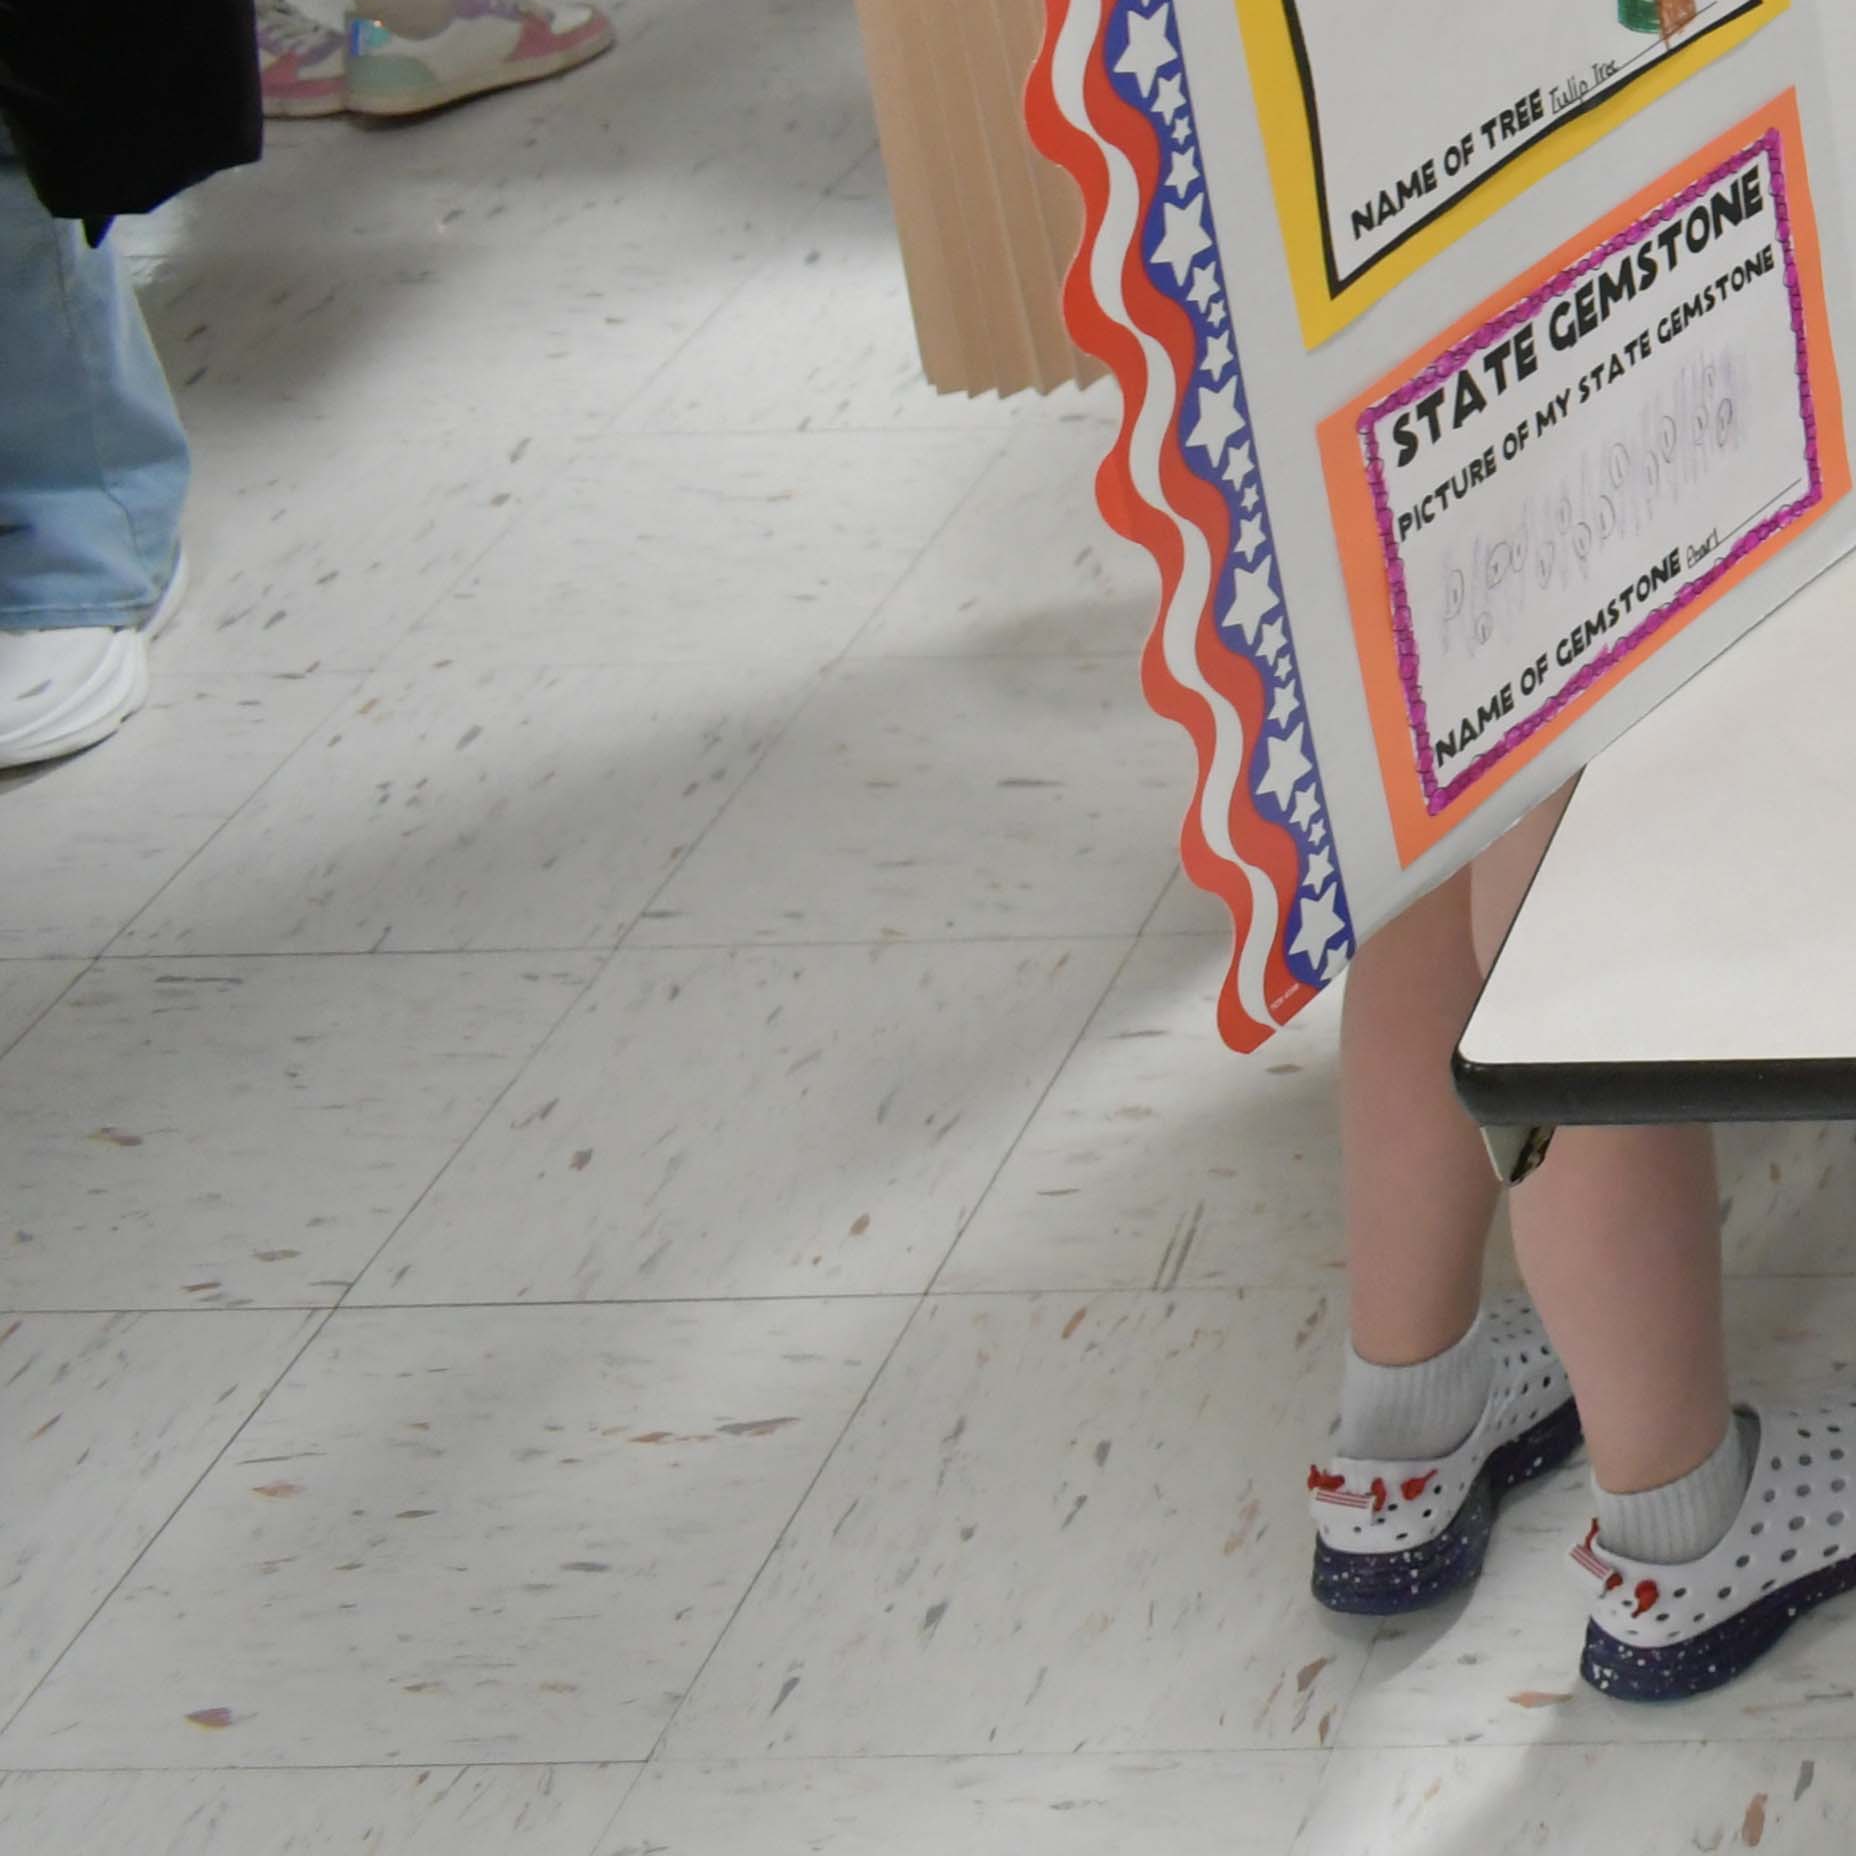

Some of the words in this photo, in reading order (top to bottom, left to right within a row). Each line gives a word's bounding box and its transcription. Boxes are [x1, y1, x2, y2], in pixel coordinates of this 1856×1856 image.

[1350, 158, 1438, 241] NAME
[1443, 134, 1476, 178] OF
[1480, 88, 1545, 152] TREE
[1548, 74, 1590, 114] Tulip
[1591, 58, 1619, 88] Tree
[1391, 322, 1538, 469] STATE
[1548, 164, 1765, 352] GEMSTONE
[1400, 446, 1498, 542] PICTURE
[1502, 415, 1530, 461] OF
[1535, 388, 1572, 438] MY
[1578, 329, 1653, 405] STATE
[1656, 243, 1776, 345] GEMSTONE
[1434, 683, 1515, 769] NAME
[1519, 654, 1549, 697] OF
[1555, 547, 1682, 667] GEMSTONE
